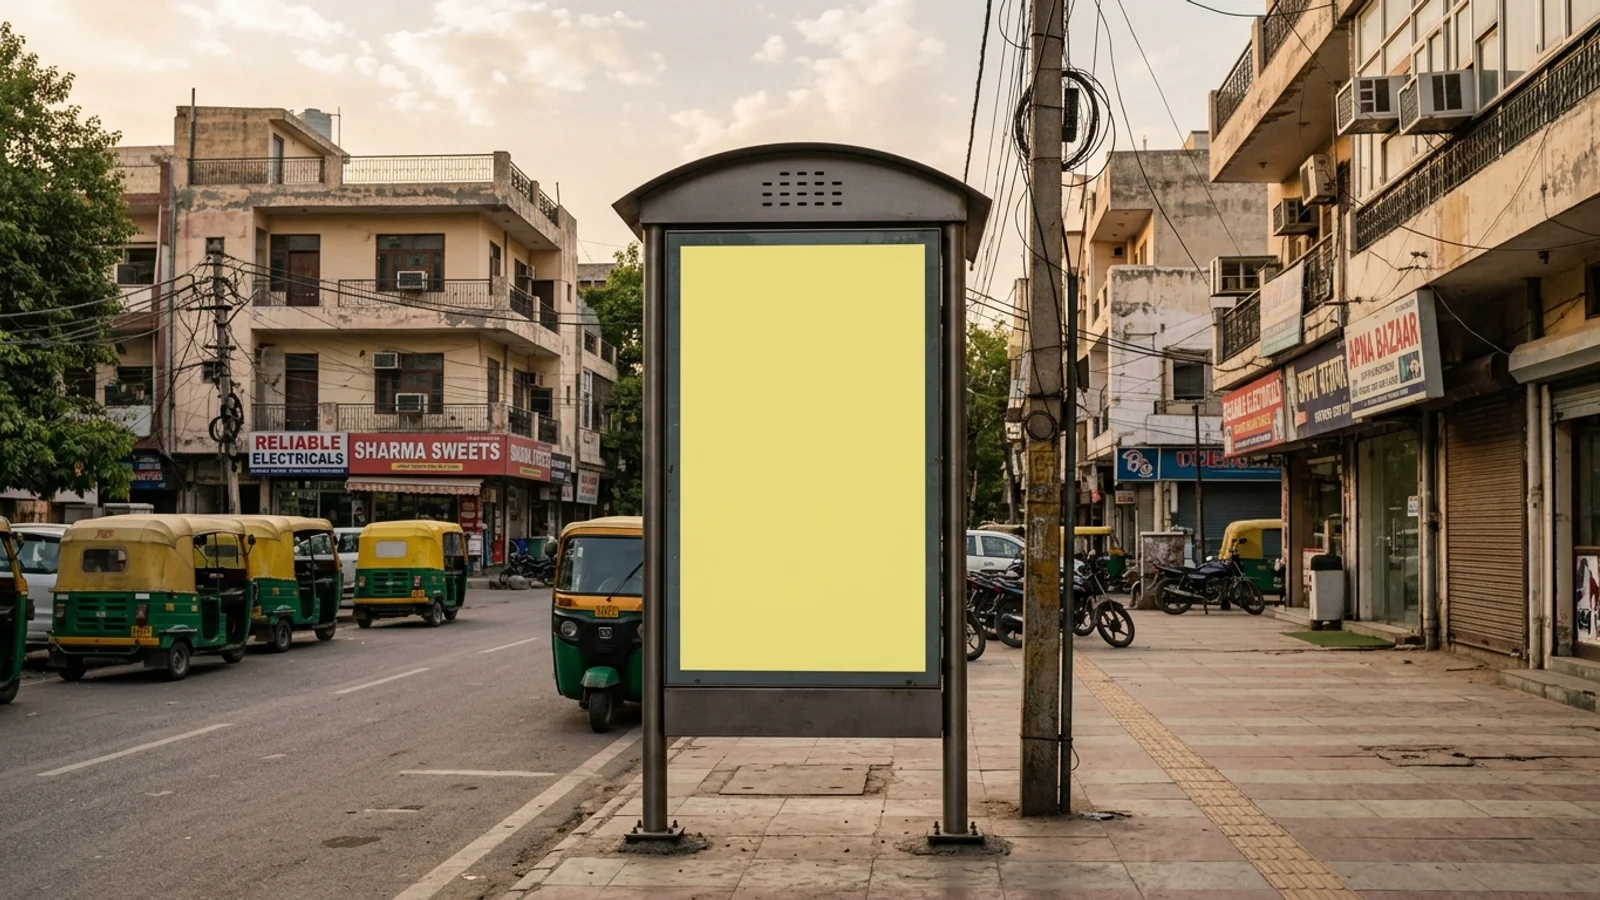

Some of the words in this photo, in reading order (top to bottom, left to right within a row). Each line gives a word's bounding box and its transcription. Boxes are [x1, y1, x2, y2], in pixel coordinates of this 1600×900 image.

[1349, 331, 1374, 370] APNA
[1375, 311, 1419, 359] BAZAAR
[255, 435, 341, 450] RELIABLE
[354, 441, 427, 460] SHARMA
[431, 442, 501, 460] SWEETS
[252, 452, 344, 465] ELECTRICALS
